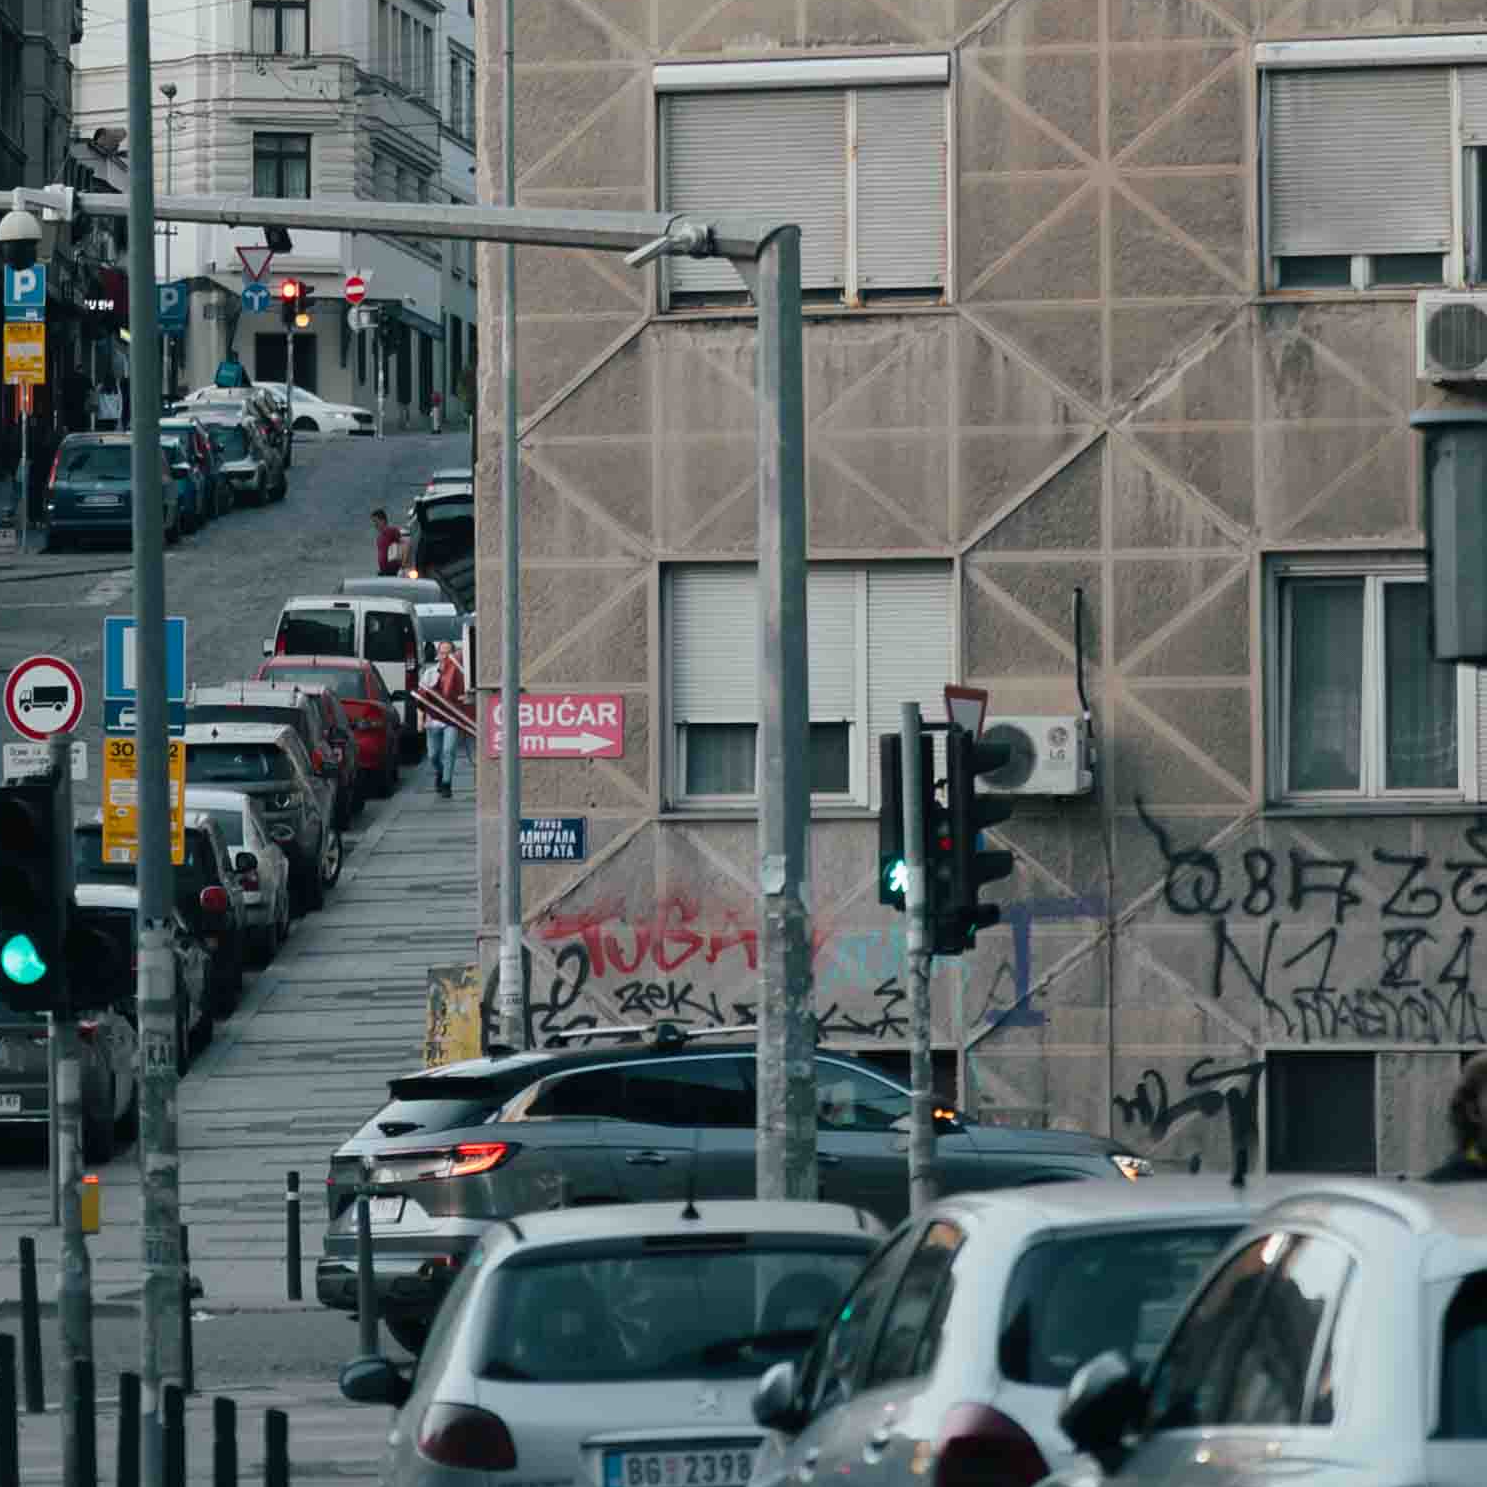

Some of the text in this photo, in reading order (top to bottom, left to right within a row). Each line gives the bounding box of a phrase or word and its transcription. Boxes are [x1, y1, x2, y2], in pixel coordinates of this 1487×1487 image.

[14, 269, 36, 301] P
[627, 1451, 754, 1486] BG 2398
